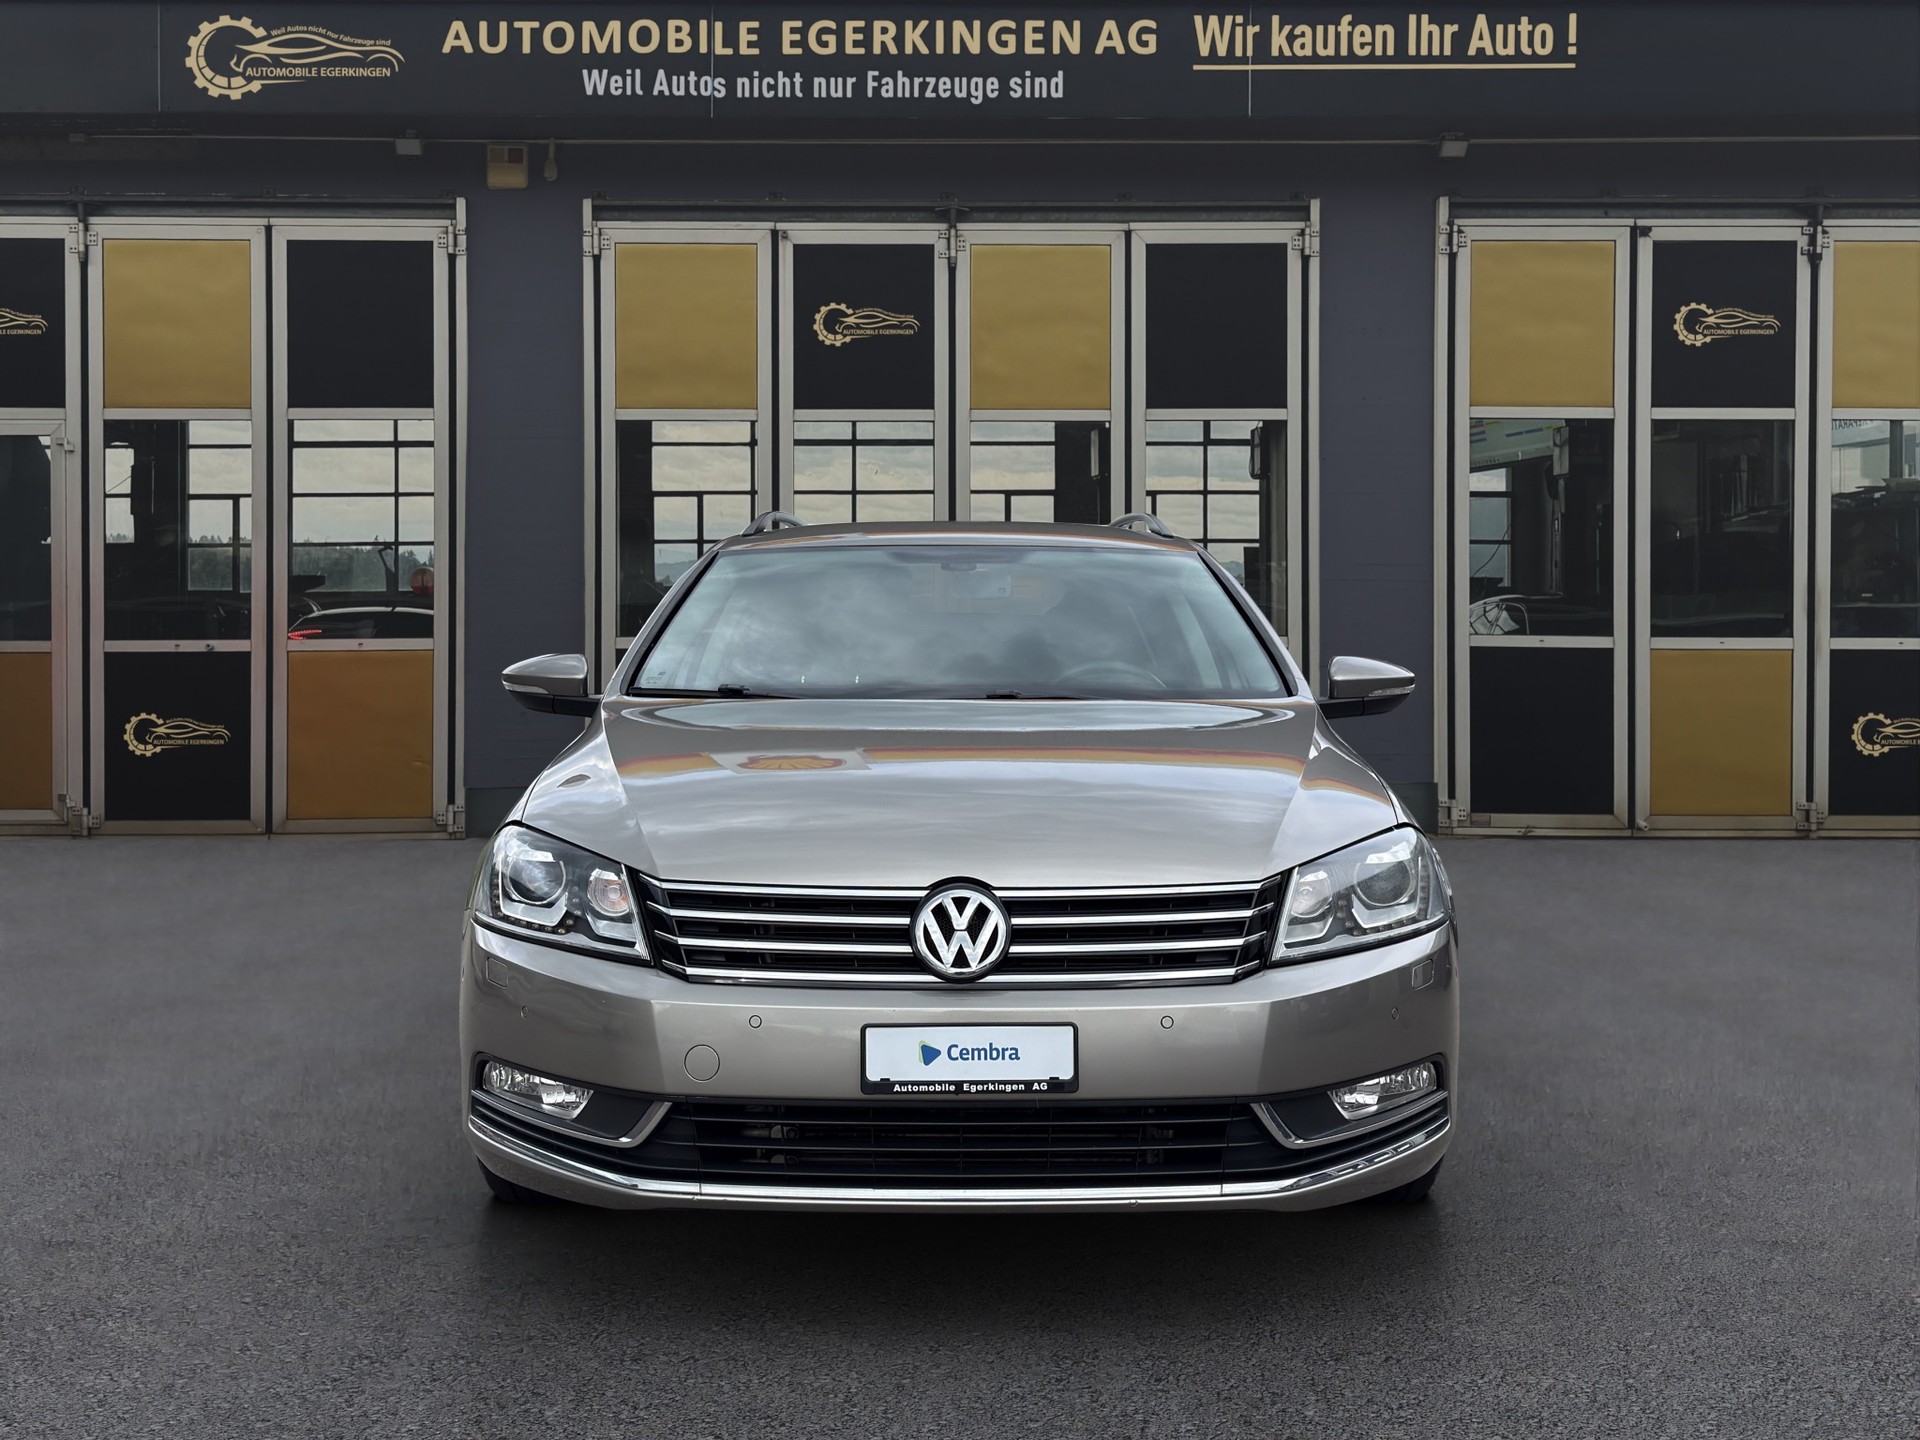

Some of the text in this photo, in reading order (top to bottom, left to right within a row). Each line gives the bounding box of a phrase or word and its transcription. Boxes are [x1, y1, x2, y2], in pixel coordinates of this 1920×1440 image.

[271, 27, 286, 36] Weil
[308, 26, 327, 35] nicht
[326, 31, 339, 39] nur
[339, 34, 375, 46] Fahrzeuge
[441, 19, 1157, 55] AUTOMOBILE EGERKINGEN AG
[1193, 14, 1260, 57] Wir
[1270, 14, 1395, 57] kaufen
[1407, 13, 1459, 56] Ihr
[1467, 13, 1554, 56] Auto
[245, 66, 391, 77] AUTOMOBILE EGERKINGEN
[581, 68, 1064, 104] Weil Autos nicht nur Fahrzeuge sind
[946, 1042, 1021, 1062] Cembra
[893, 1082, 1048, 1093] Automobile Egerkingen AG
